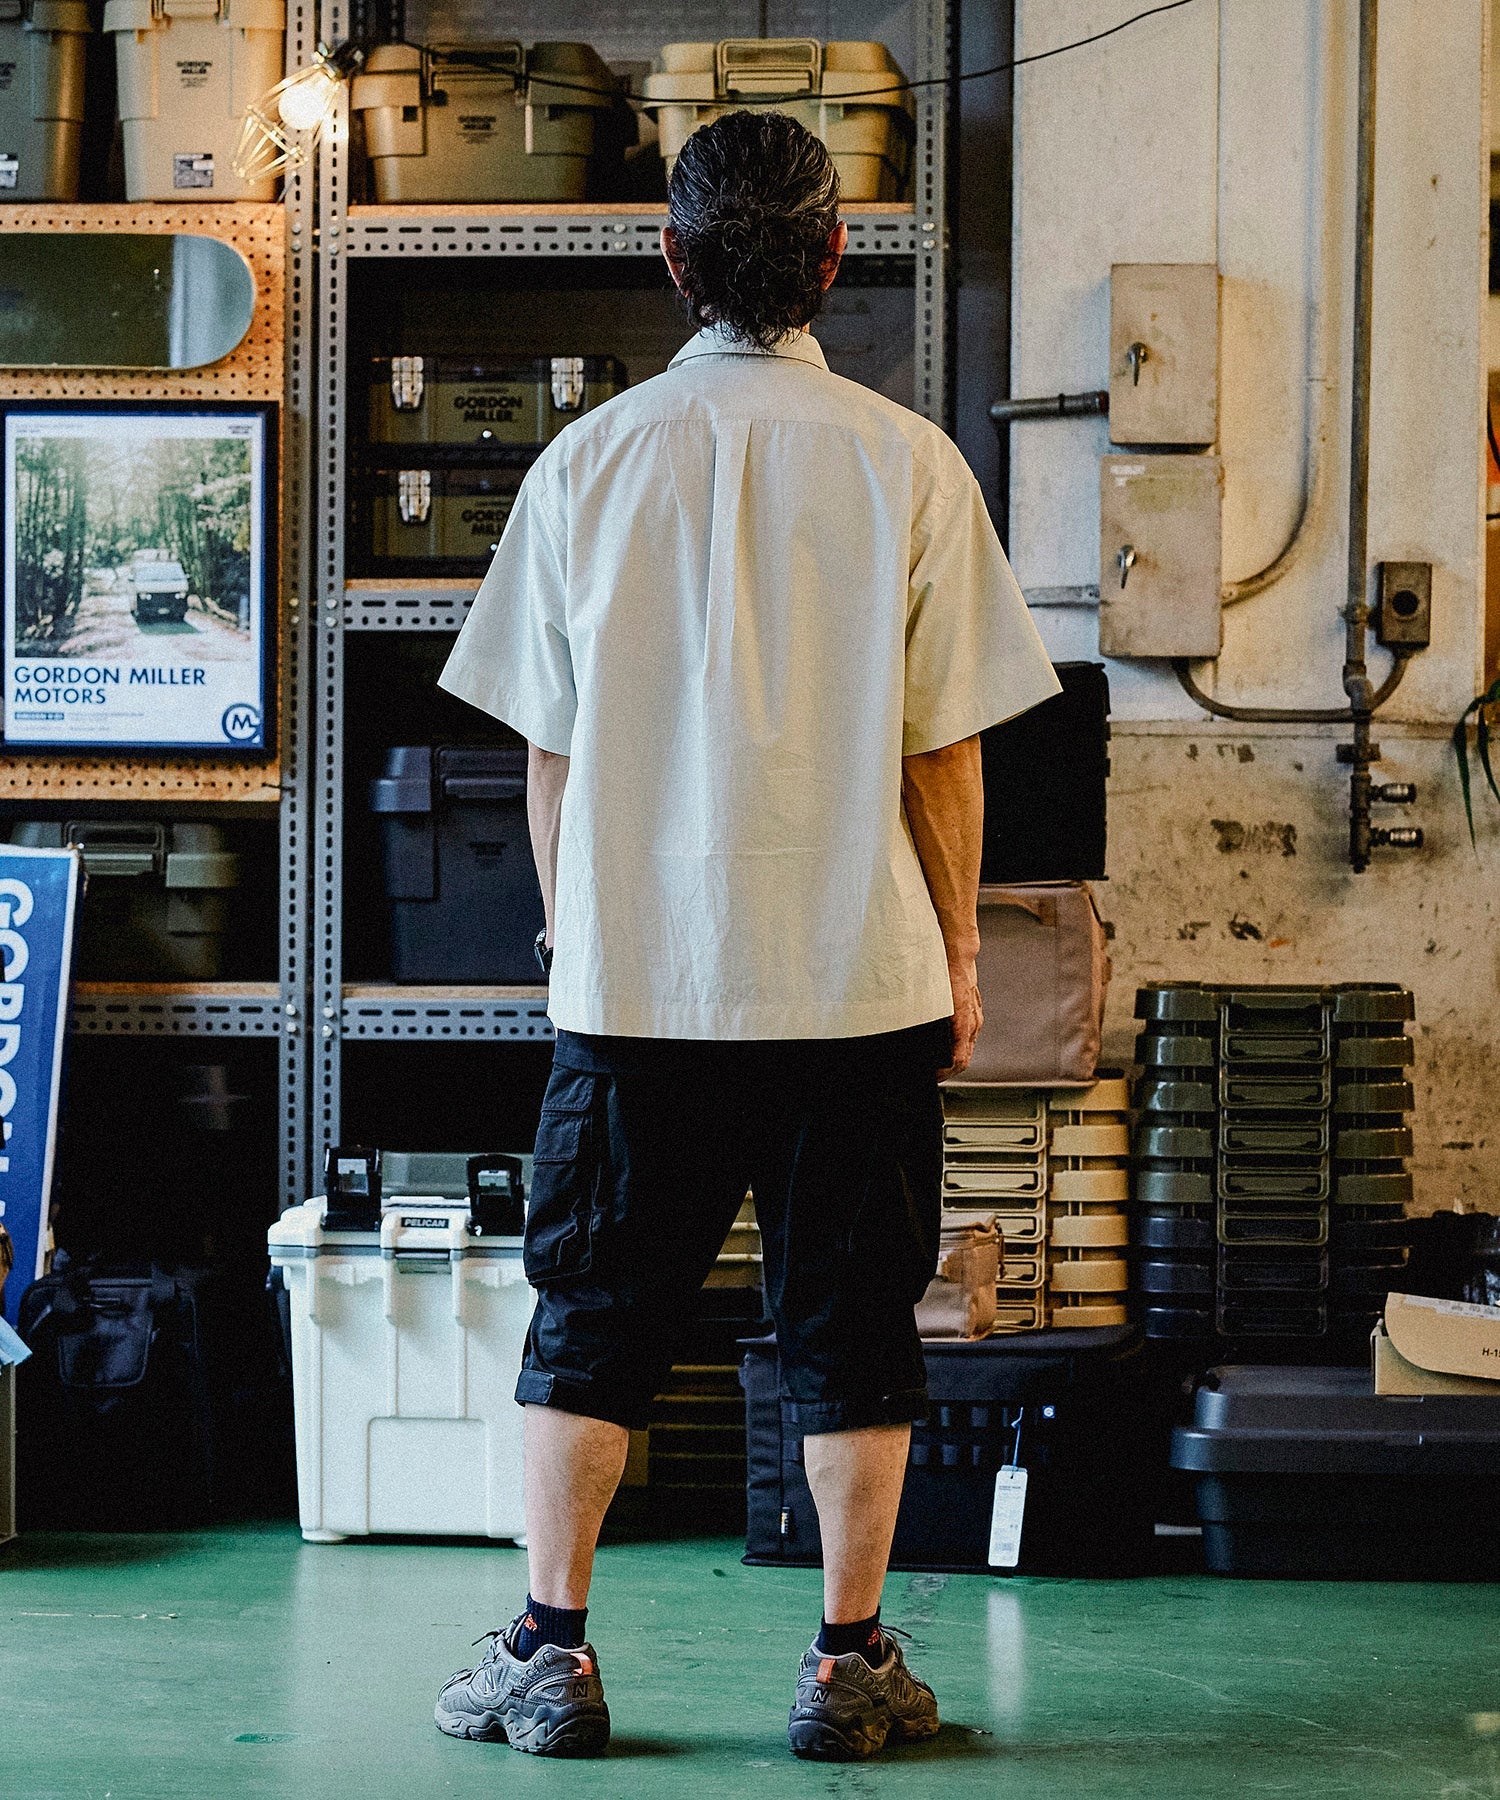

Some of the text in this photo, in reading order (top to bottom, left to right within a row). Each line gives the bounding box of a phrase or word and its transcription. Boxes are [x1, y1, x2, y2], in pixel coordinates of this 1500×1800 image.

[454, 396, 523, 409] GORDON
[464, 409, 513, 422] MILLER
[461, 509, 511, 522] GORD
[14, 667, 206, 685] GORDON MILLER
[14, 688, 106, 704] MOTORS
[404, 1218, 446, 1227] PELICAN
[1481, 1347, 1500, 1358] H-1
[573, 1685, 588, 1698] N
[812, 1687, 830, 1703] N
